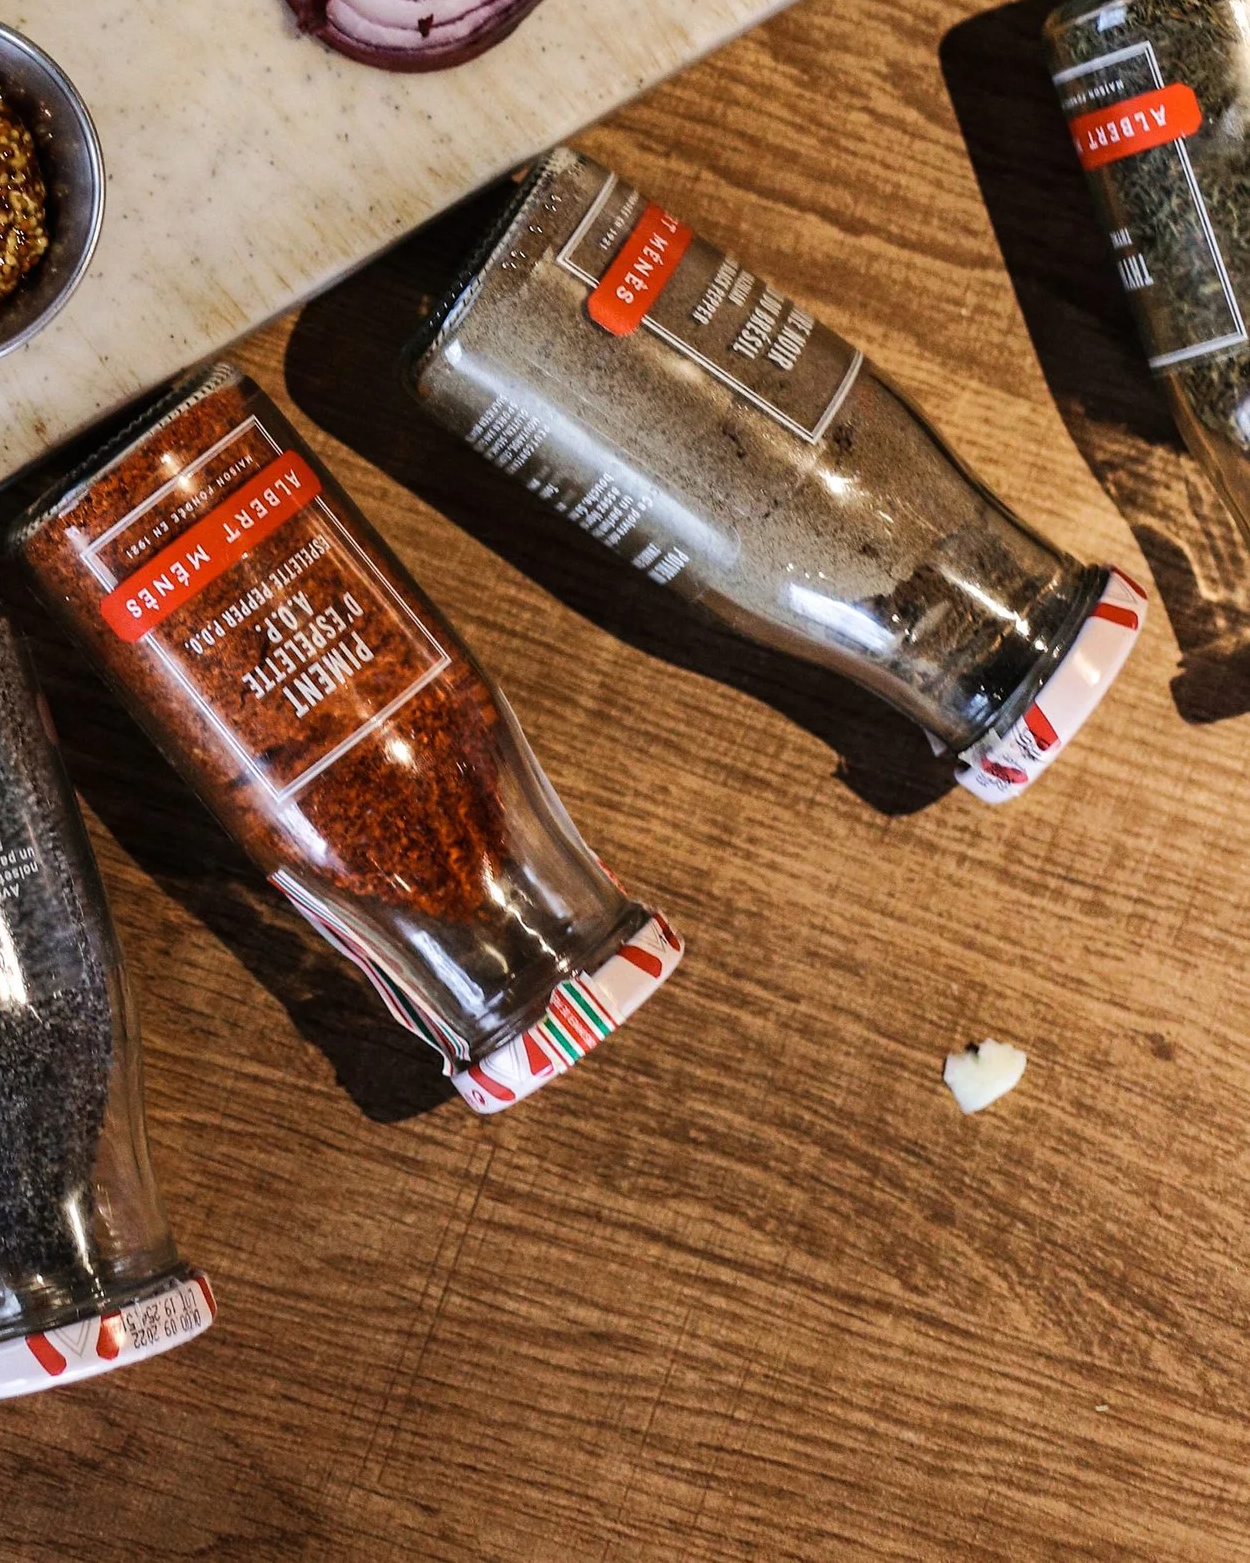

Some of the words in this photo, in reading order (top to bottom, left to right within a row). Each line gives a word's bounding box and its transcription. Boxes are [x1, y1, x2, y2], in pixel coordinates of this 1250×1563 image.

[1085, 103, 1167, 150] ALBERT
[613, 231, 673, 308] MÉNÈS
[692, 282, 724, 326] PEPPER
[731, 306, 781, 364] BRÉSIL
[766, 324, 806, 371] NOIR
[215, 453, 254, 487] MAISON
[152, 520, 168, 537] EN
[169, 485, 214, 525] FONDÉE
[218, 468, 302, 542] ALBERT
[124, 535, 150, 559] 1921
[268, 533, 329, 587] ESPELETTE
[123, 543, 215, 622] MÉNÈS
[219, 580, 272, 629] PEPPER
[183, 620, 226, 658] P.D.O.
[254, 589, 314, 646] A.O.P.
[240, 590, 364, 699] D'ESPELETTE
[281, 630, 374, 718] PIMENT
[18, 846, 35, 862] un
